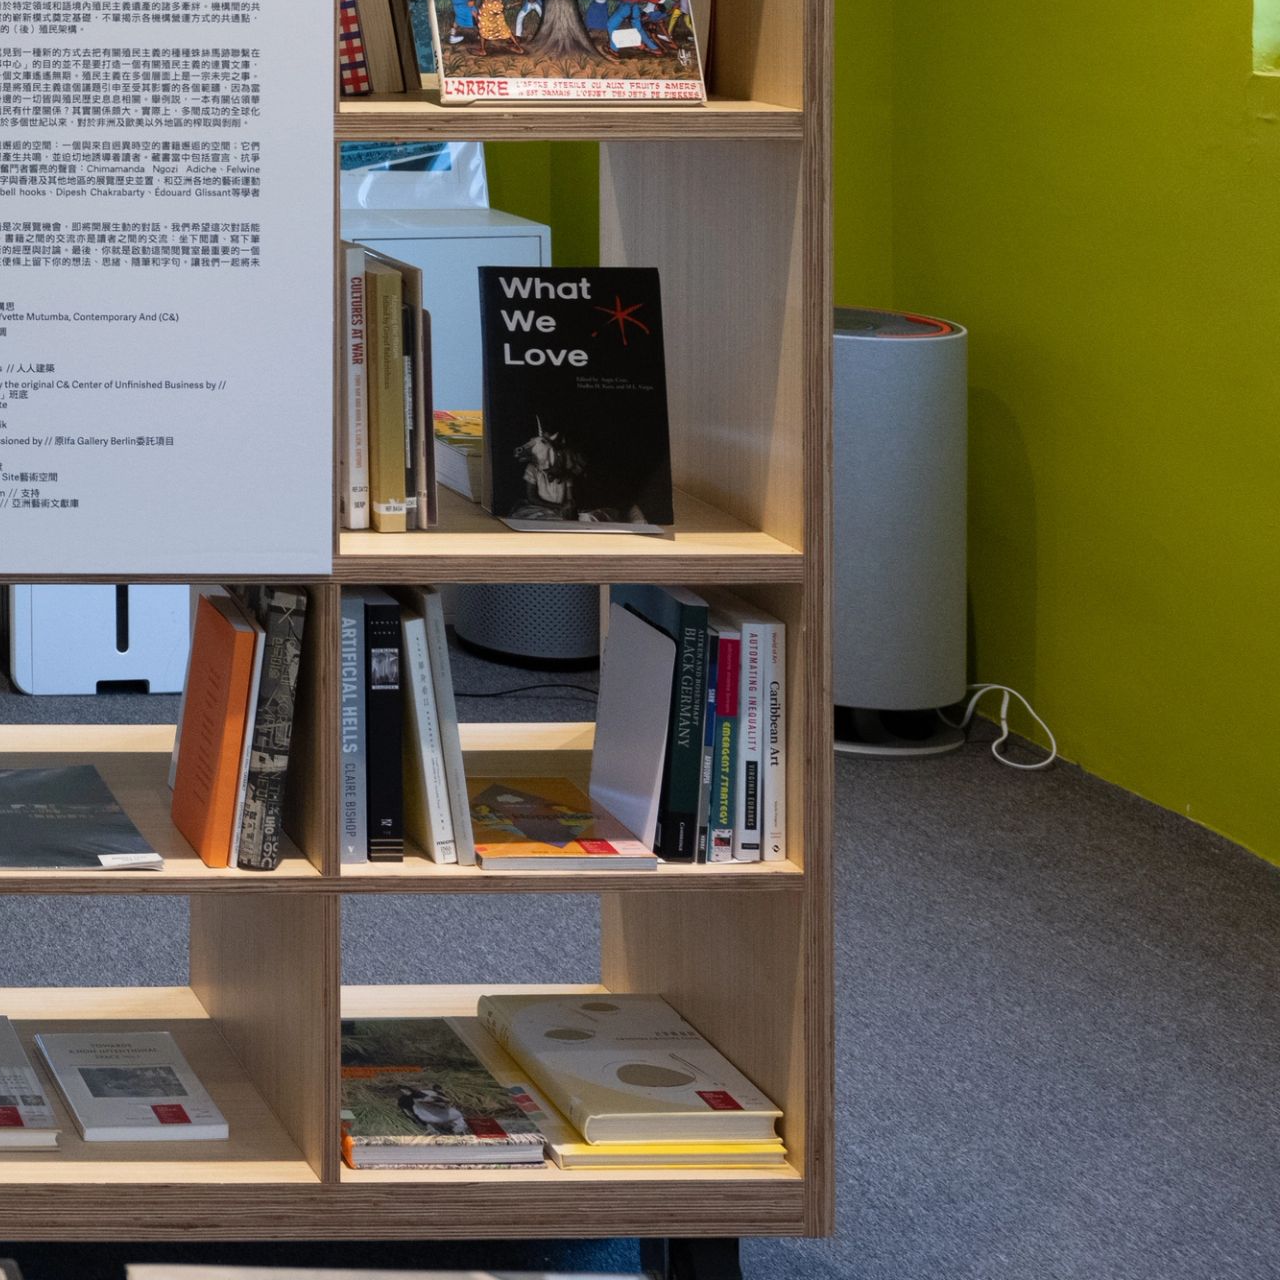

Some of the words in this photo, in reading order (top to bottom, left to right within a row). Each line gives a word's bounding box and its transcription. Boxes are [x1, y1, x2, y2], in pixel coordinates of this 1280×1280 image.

[498, 276, 592, 300] What
[26, 313, 71, 322] Mutumba,
[73, 313, 137, 323] Contemporary
[139, 313, 157, 321] And
[159, 313, 179, 322] (C&)
[501, 310, 557, 334] We
[504, 343, 589, 367] Love
[341, 617, 358, 703] ARTIFICIAL
[682, 628, 696, 672] BLACK
[748, 632, 758, 693] AUTOMATING
[342, 706, 358, 754] HELLS
[678, 674, 693, 748] GERMANY
[747, 696, 757, 752] INEQUALITY
[770, 681, 781, 744] Caribbean
[770, 746, 779, 766] Art
[344, 763, 357, 798] CLAIRE
[345, 801, 357, 837] BISHOP
